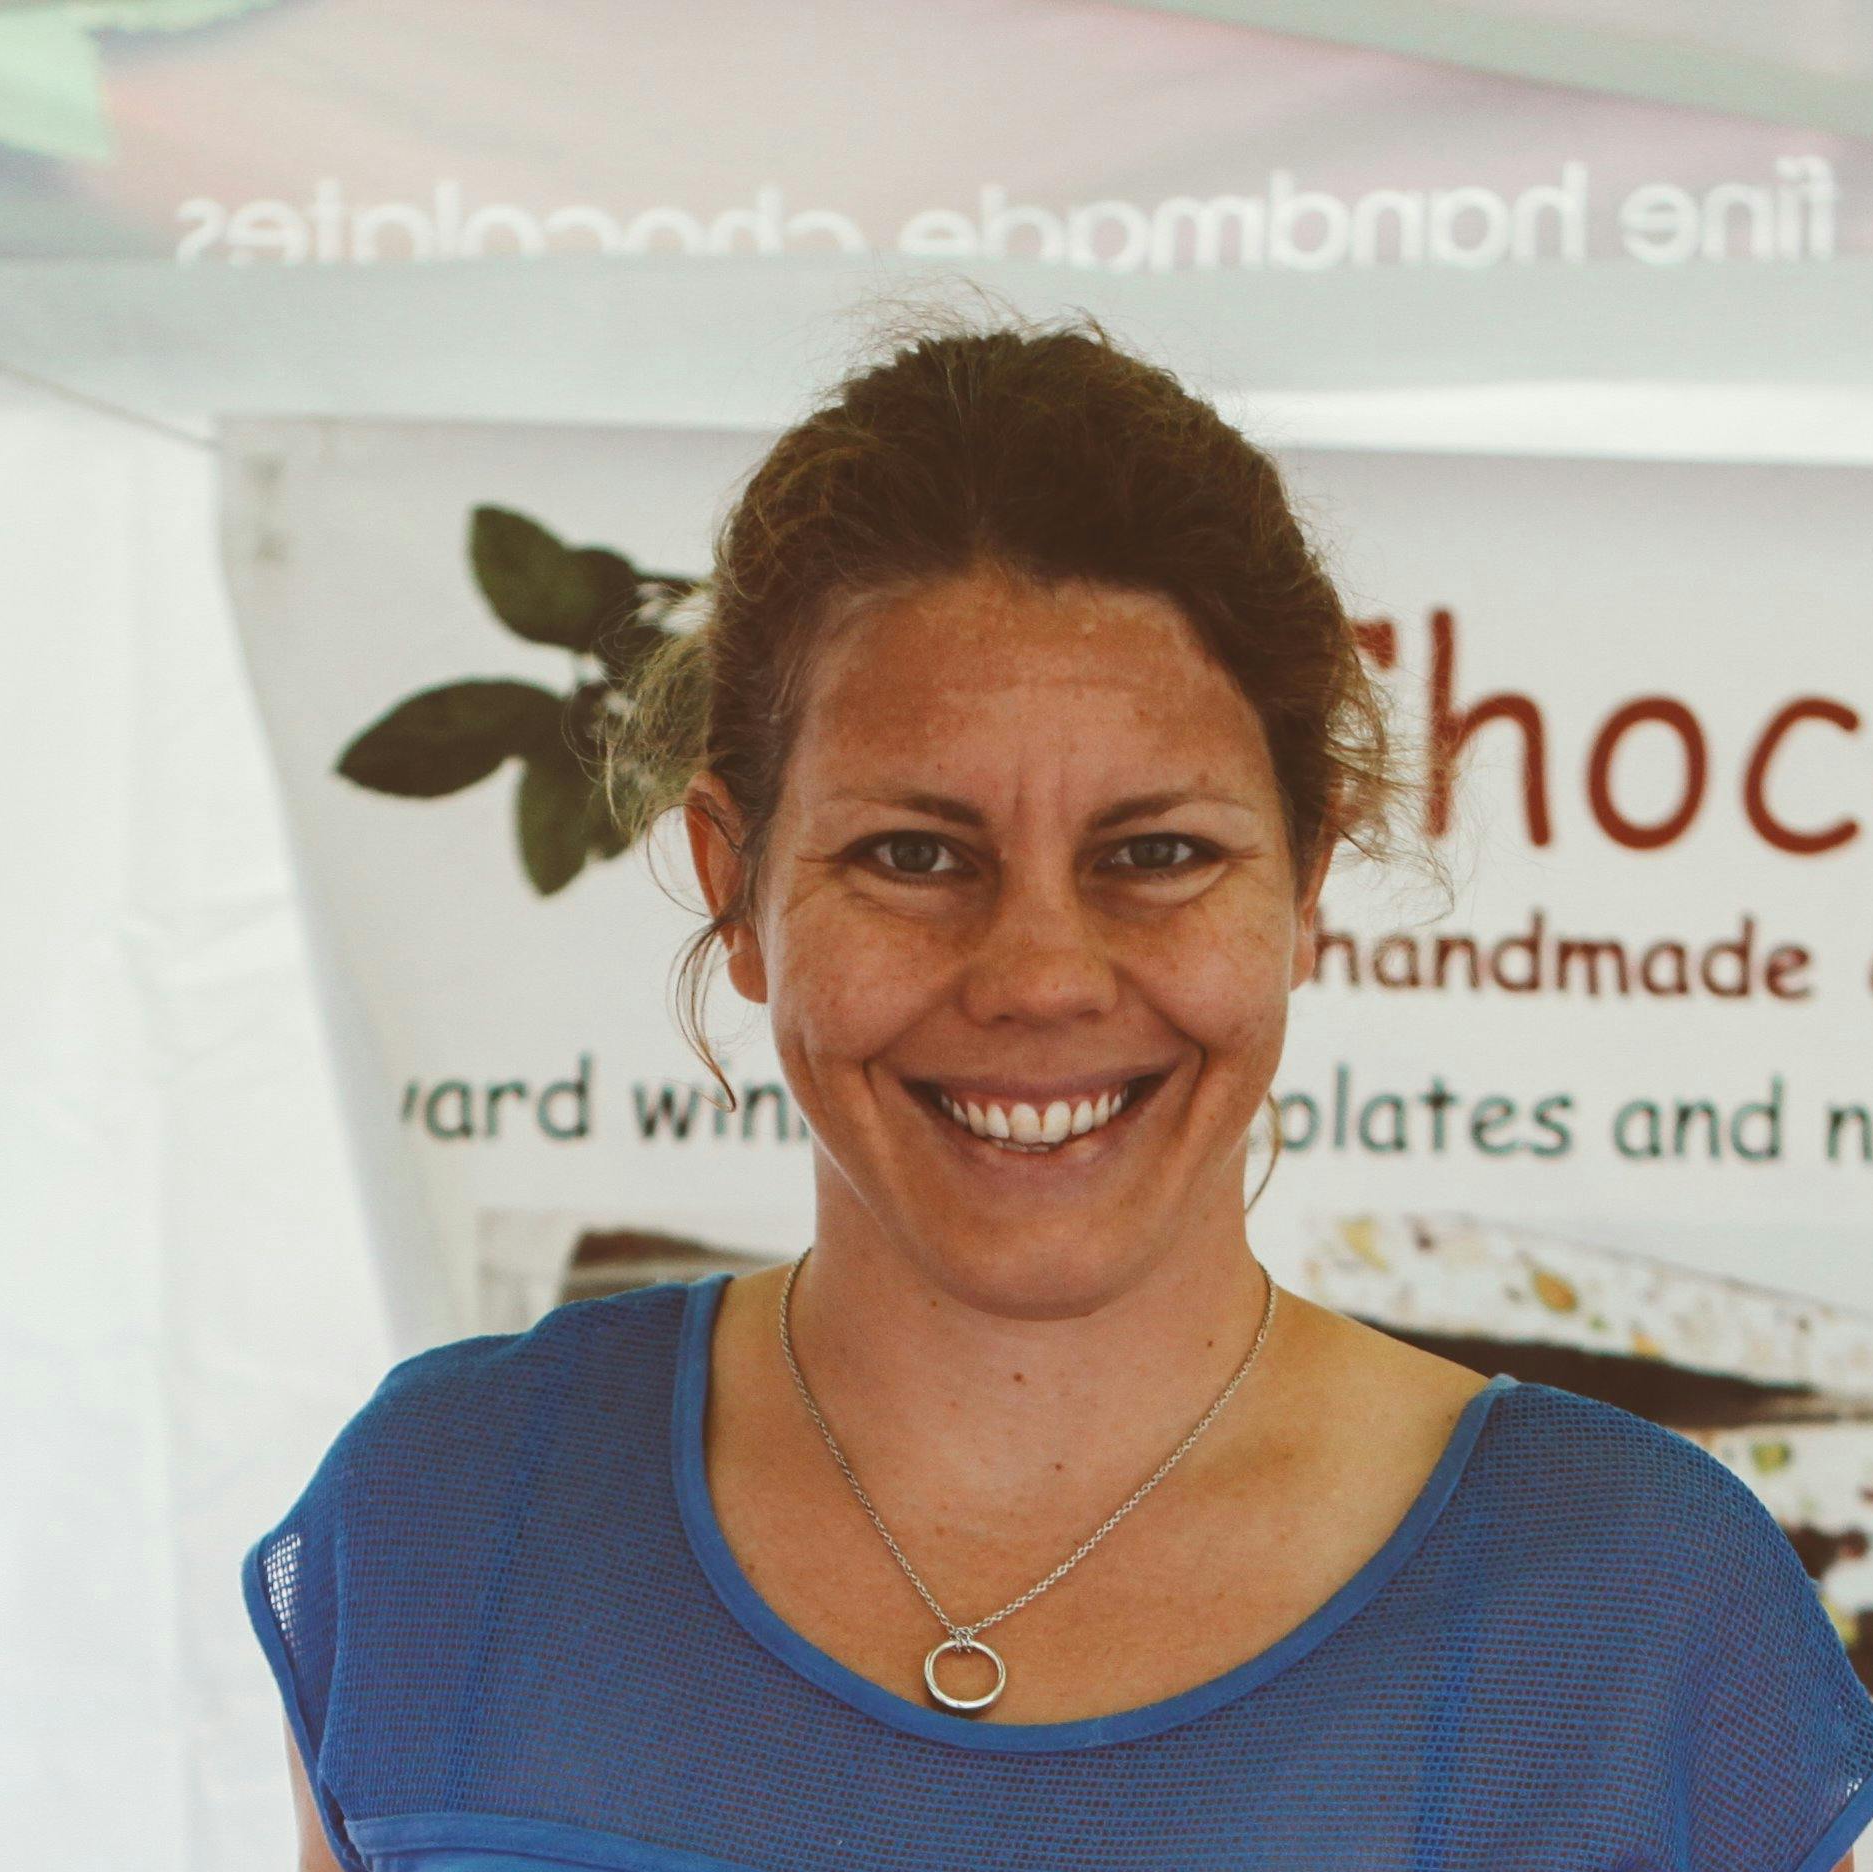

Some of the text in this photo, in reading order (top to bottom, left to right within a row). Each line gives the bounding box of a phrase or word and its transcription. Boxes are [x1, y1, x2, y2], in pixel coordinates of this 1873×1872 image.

[1312, 912, 1816, 1001] handmade
[1276, 1063, 1575, 1158] olates
[1612, 1075, 1787, 1164] and
